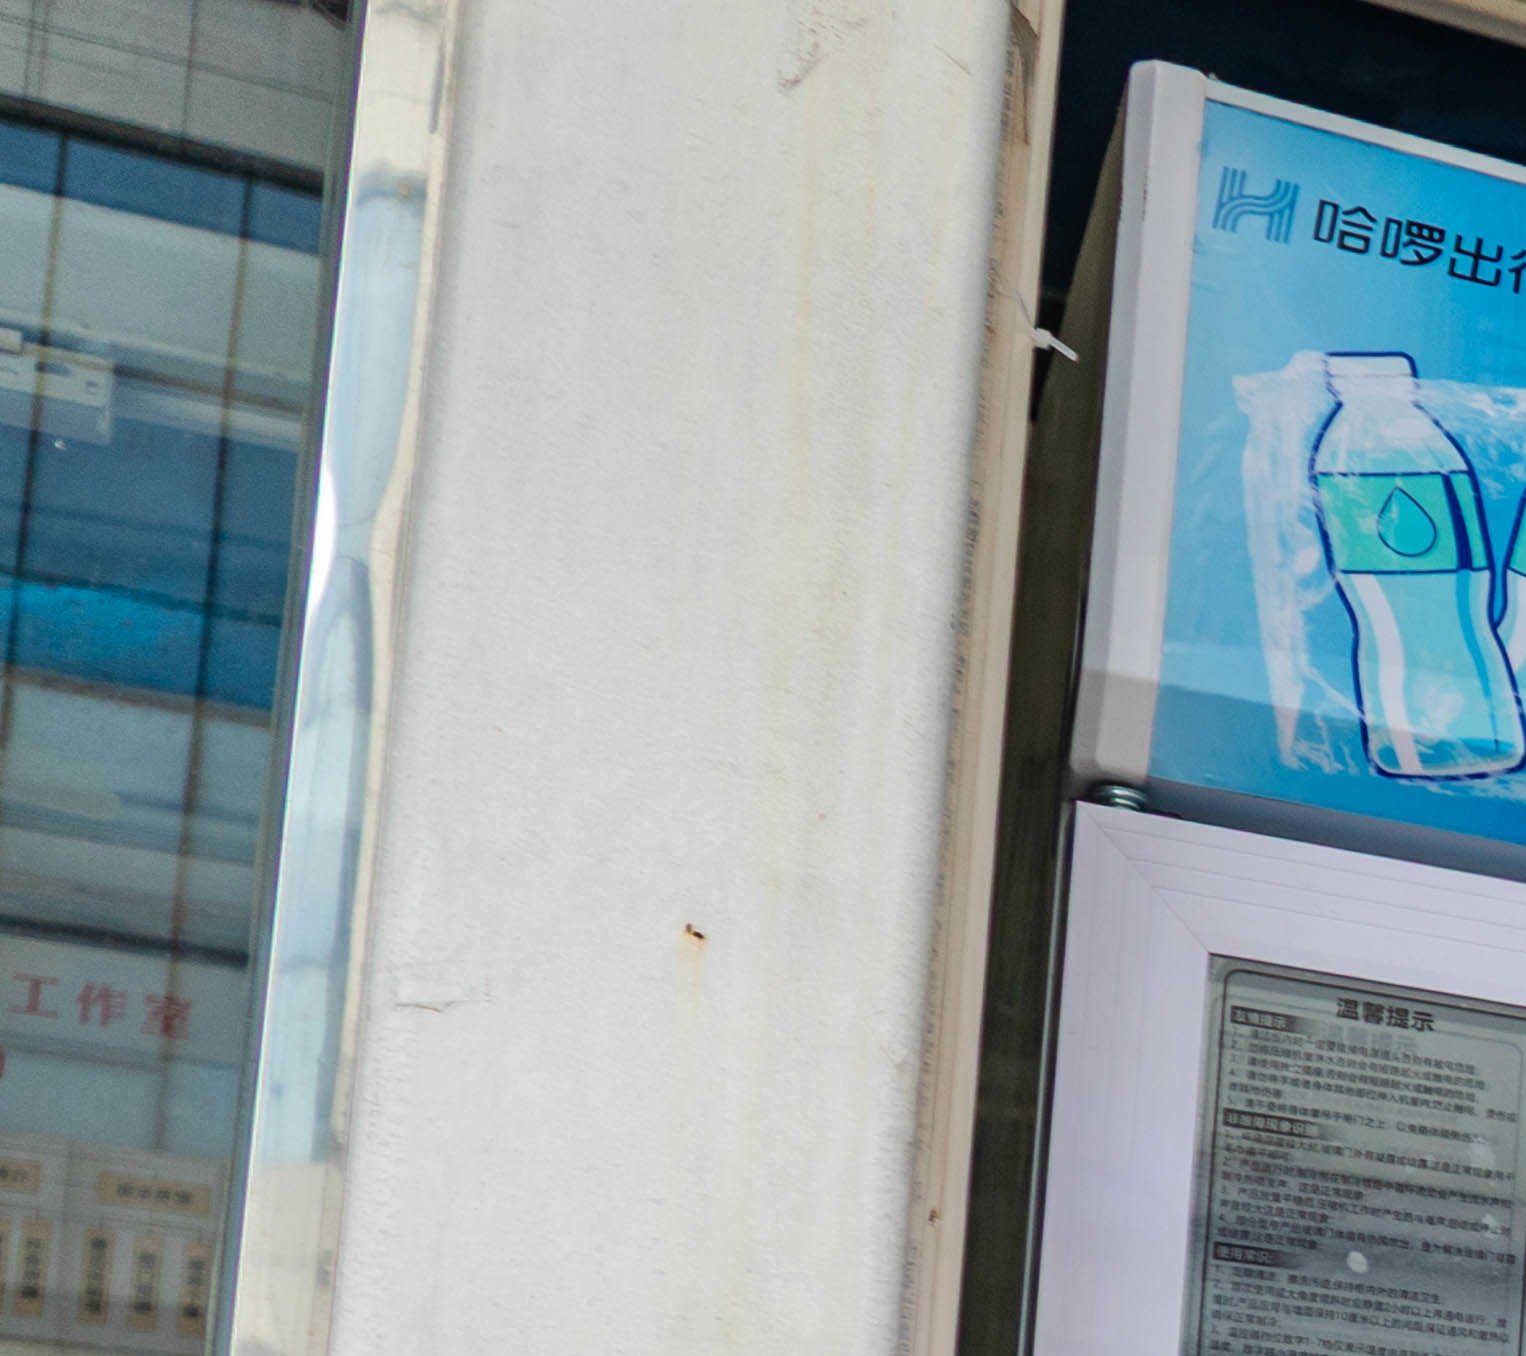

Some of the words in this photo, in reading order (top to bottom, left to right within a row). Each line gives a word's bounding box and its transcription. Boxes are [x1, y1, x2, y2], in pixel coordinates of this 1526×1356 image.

[8, 972, 193, 1042] 工作室
[1336, 996, 1436, 1032] 温馨提示
